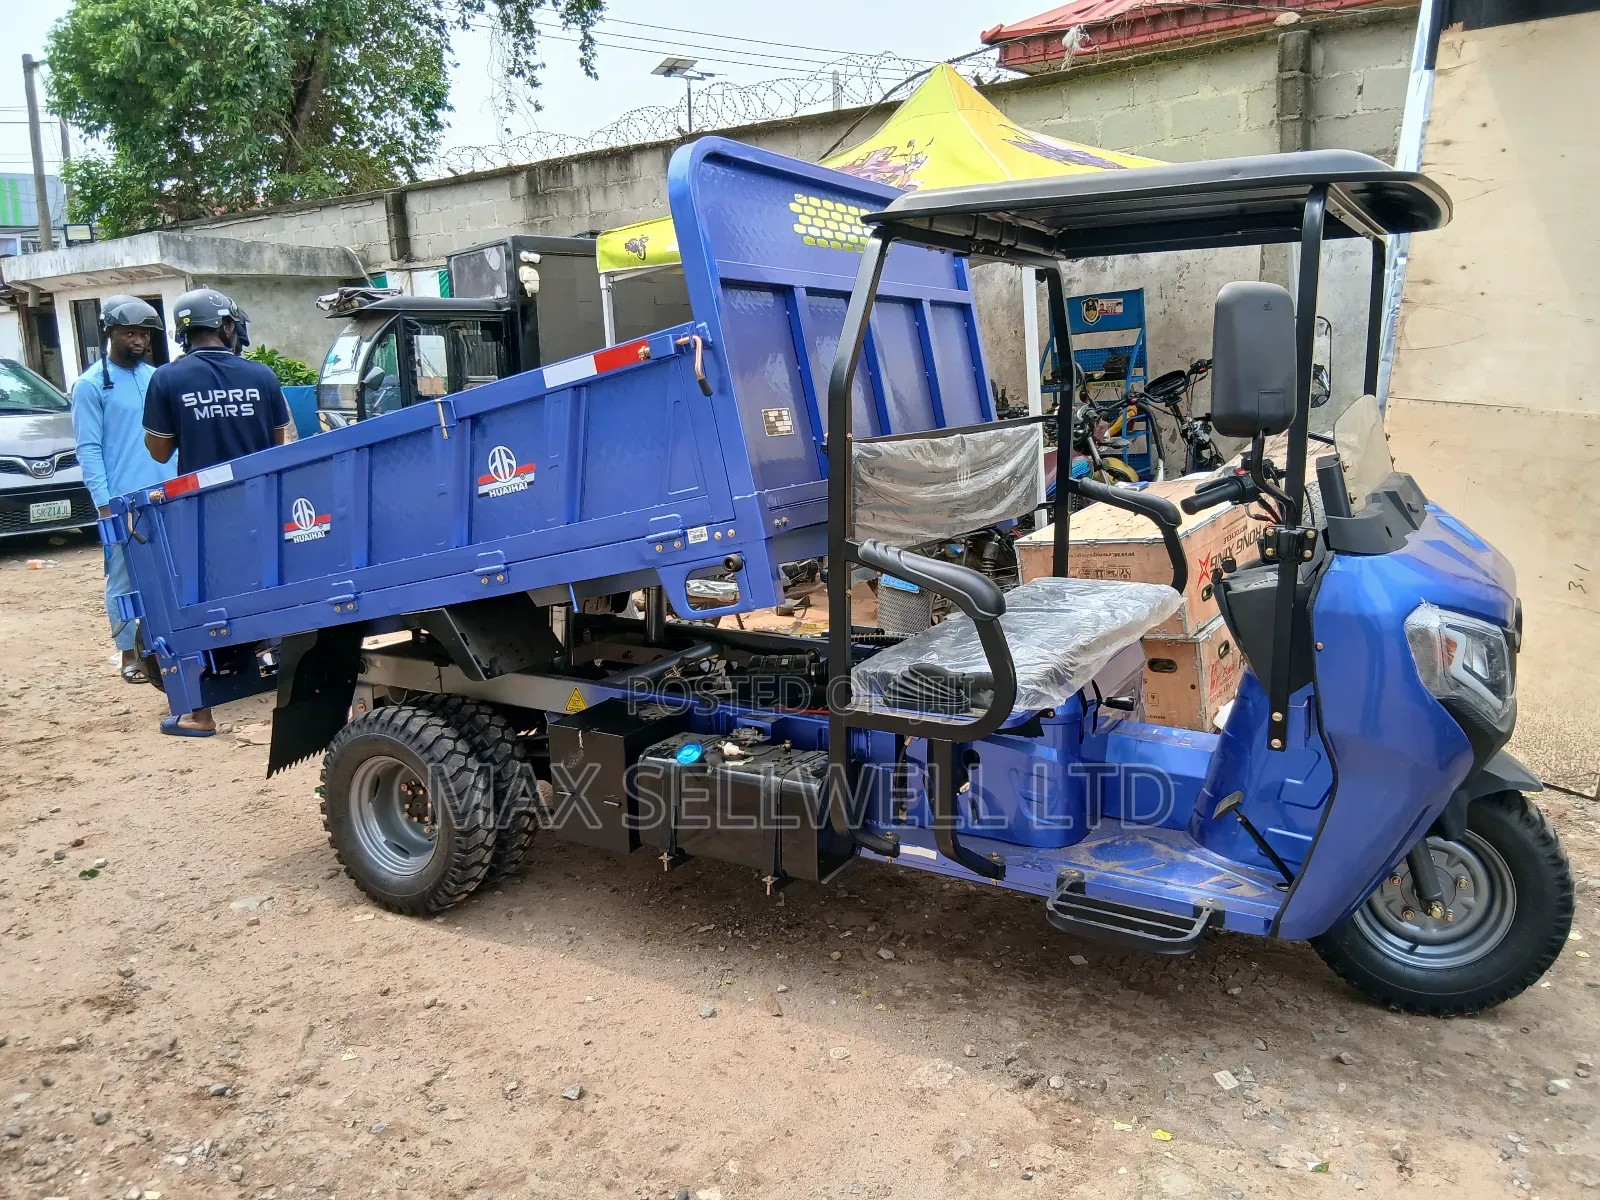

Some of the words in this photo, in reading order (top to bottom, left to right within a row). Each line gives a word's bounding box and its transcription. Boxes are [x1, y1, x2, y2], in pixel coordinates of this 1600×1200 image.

[182, 388, 261, 407] SUPRA
[193, 403, 255, 421] MARS
[489, 481, 528, 498] HUAIHAI
[294, 531, 326, 544] HUAIHAI
